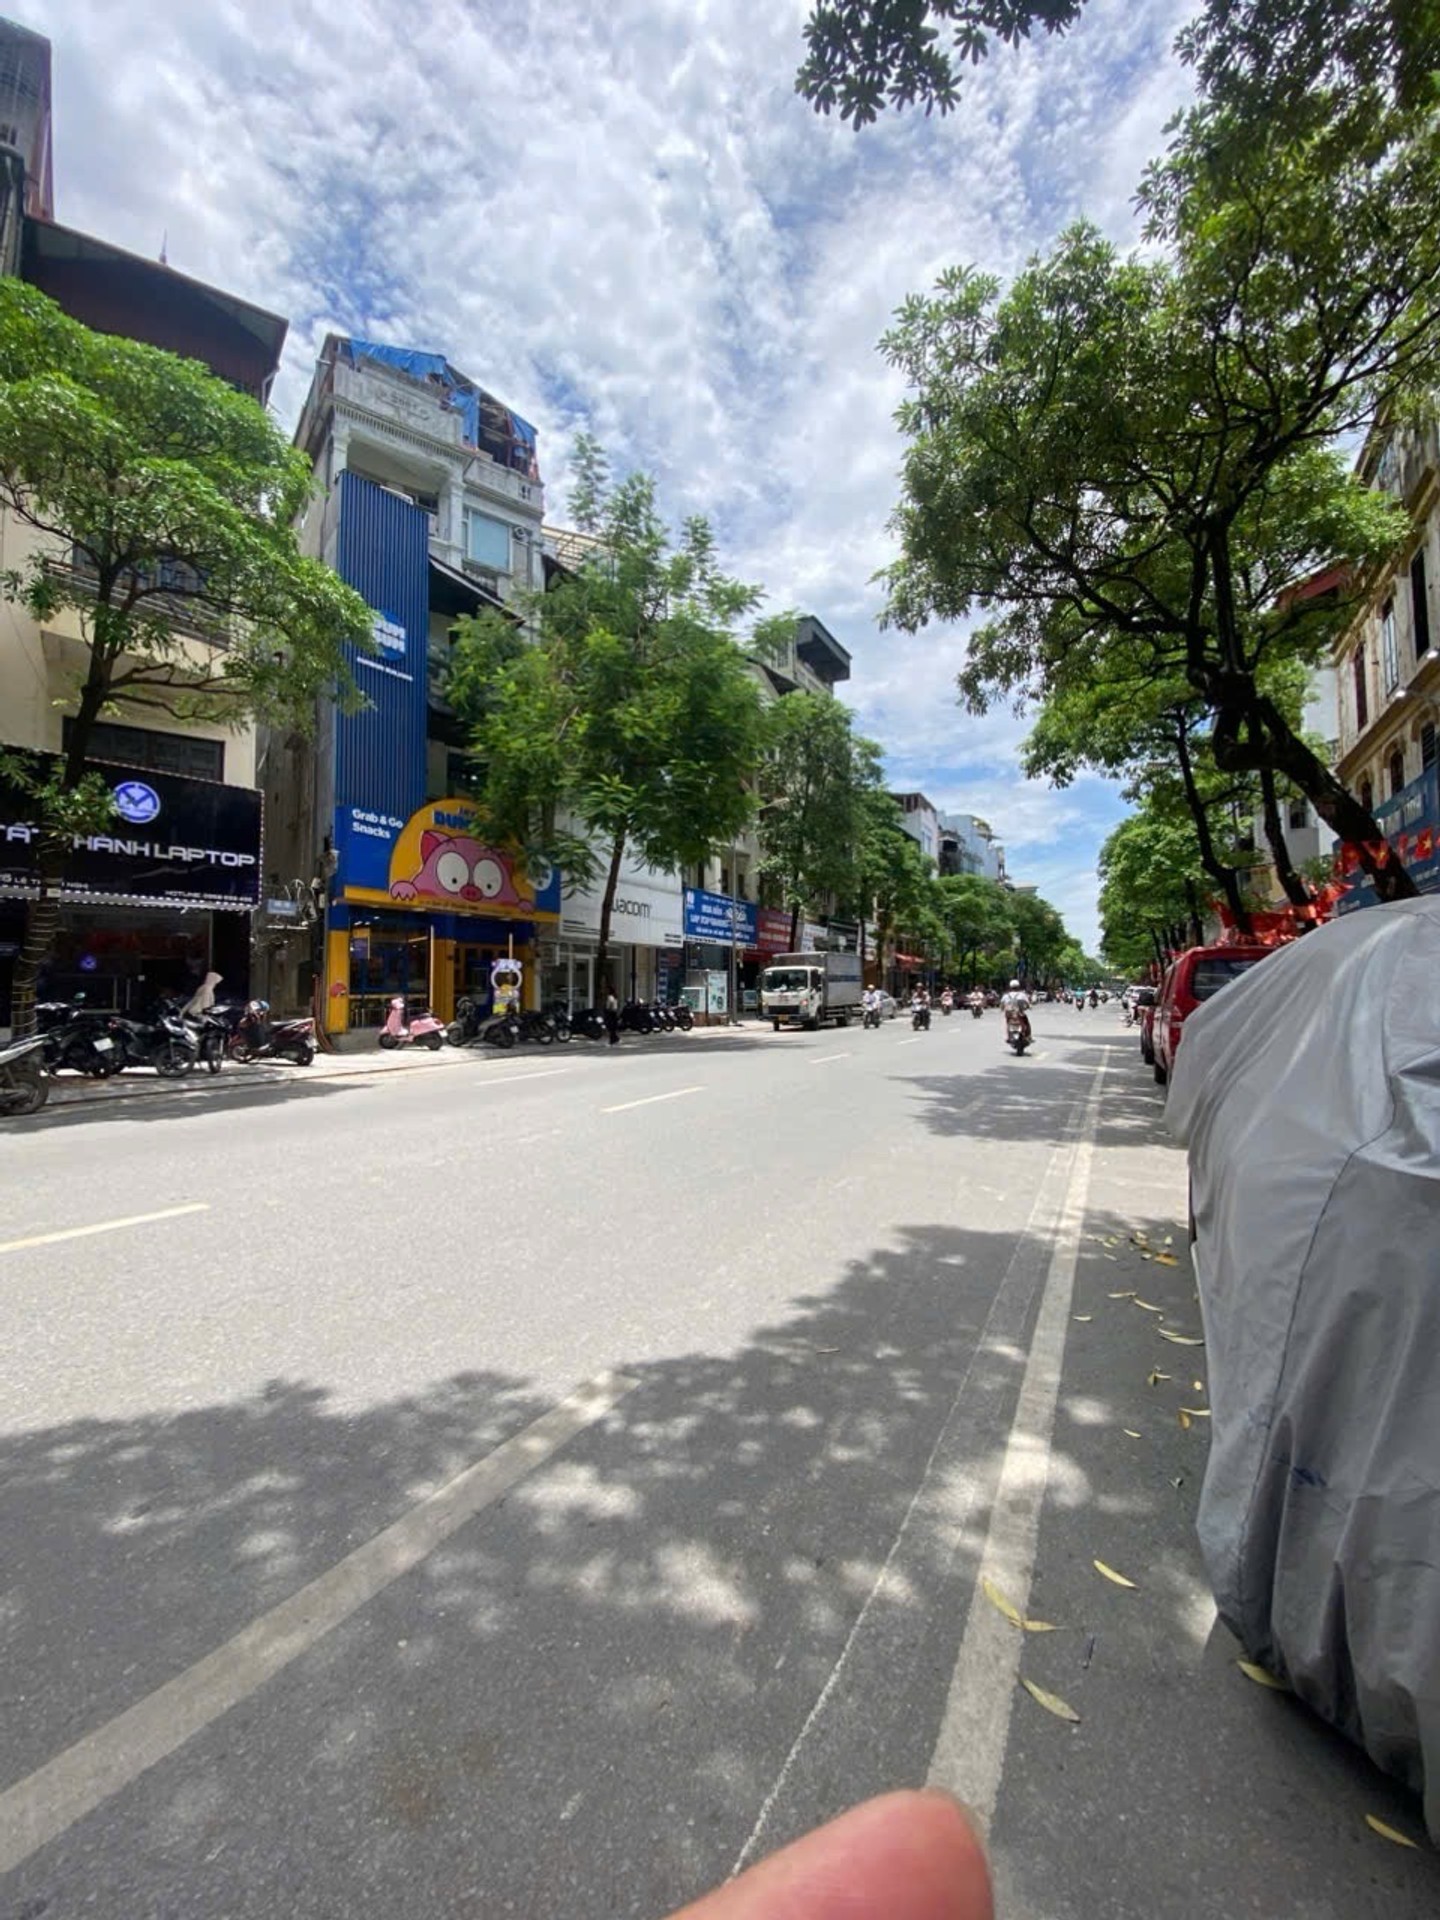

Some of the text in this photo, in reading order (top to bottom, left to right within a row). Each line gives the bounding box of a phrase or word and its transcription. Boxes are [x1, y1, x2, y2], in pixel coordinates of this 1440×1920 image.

[352, 809, 403, 829] Grab & Go
[352, 822, 391, 839] Snacks
[154, 843, 255, 867] LAPTOP
